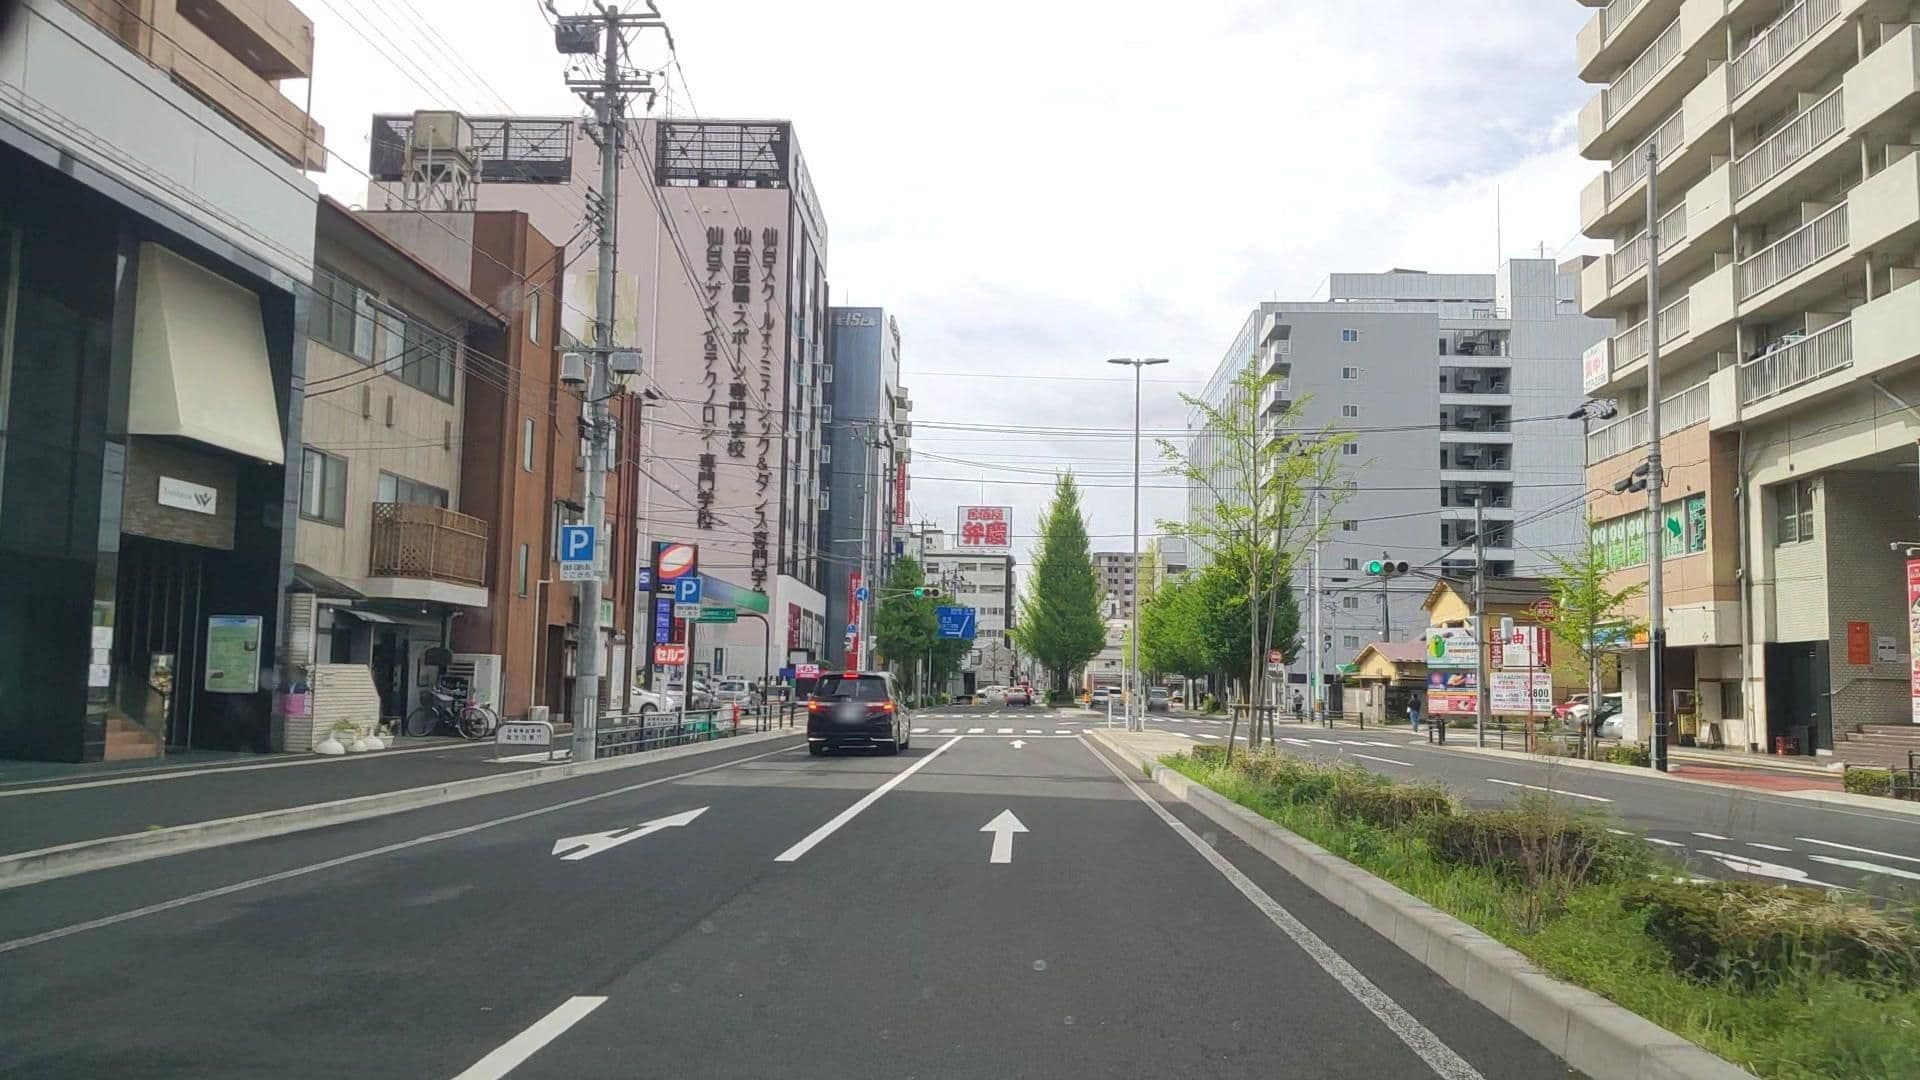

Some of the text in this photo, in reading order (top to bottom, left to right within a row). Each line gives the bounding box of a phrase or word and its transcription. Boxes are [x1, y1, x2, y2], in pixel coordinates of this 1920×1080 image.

[751, 226, 779, 593] 仙台スクールオブミュージック&ダンス専門学
[569, 529, 589, 558] P
[962, 521, 1008, 545] 弁慶
[681, 580, 697, 601] P
